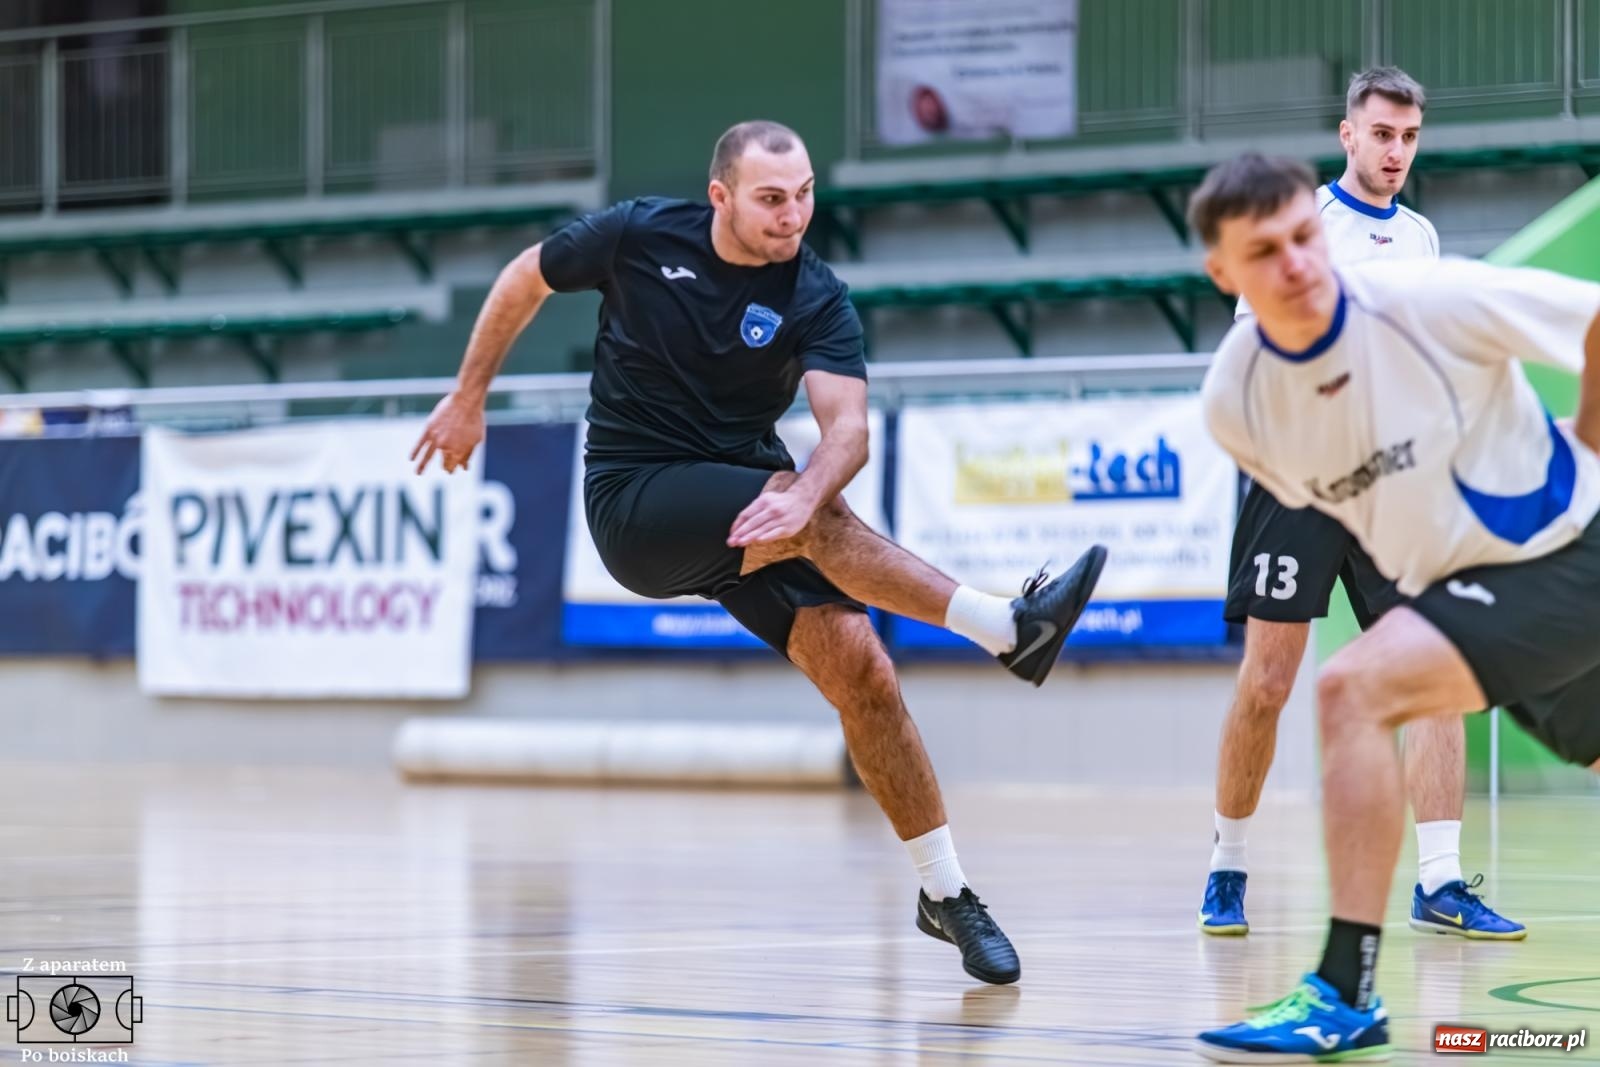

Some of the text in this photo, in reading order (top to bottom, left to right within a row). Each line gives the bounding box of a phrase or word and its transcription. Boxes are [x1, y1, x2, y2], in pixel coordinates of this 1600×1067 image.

[172, 487, 443, 566] PIVEXIN
[1254, 552, 1299, 600] 13
[178, 582, 441, 631] TECHNOLOGY
